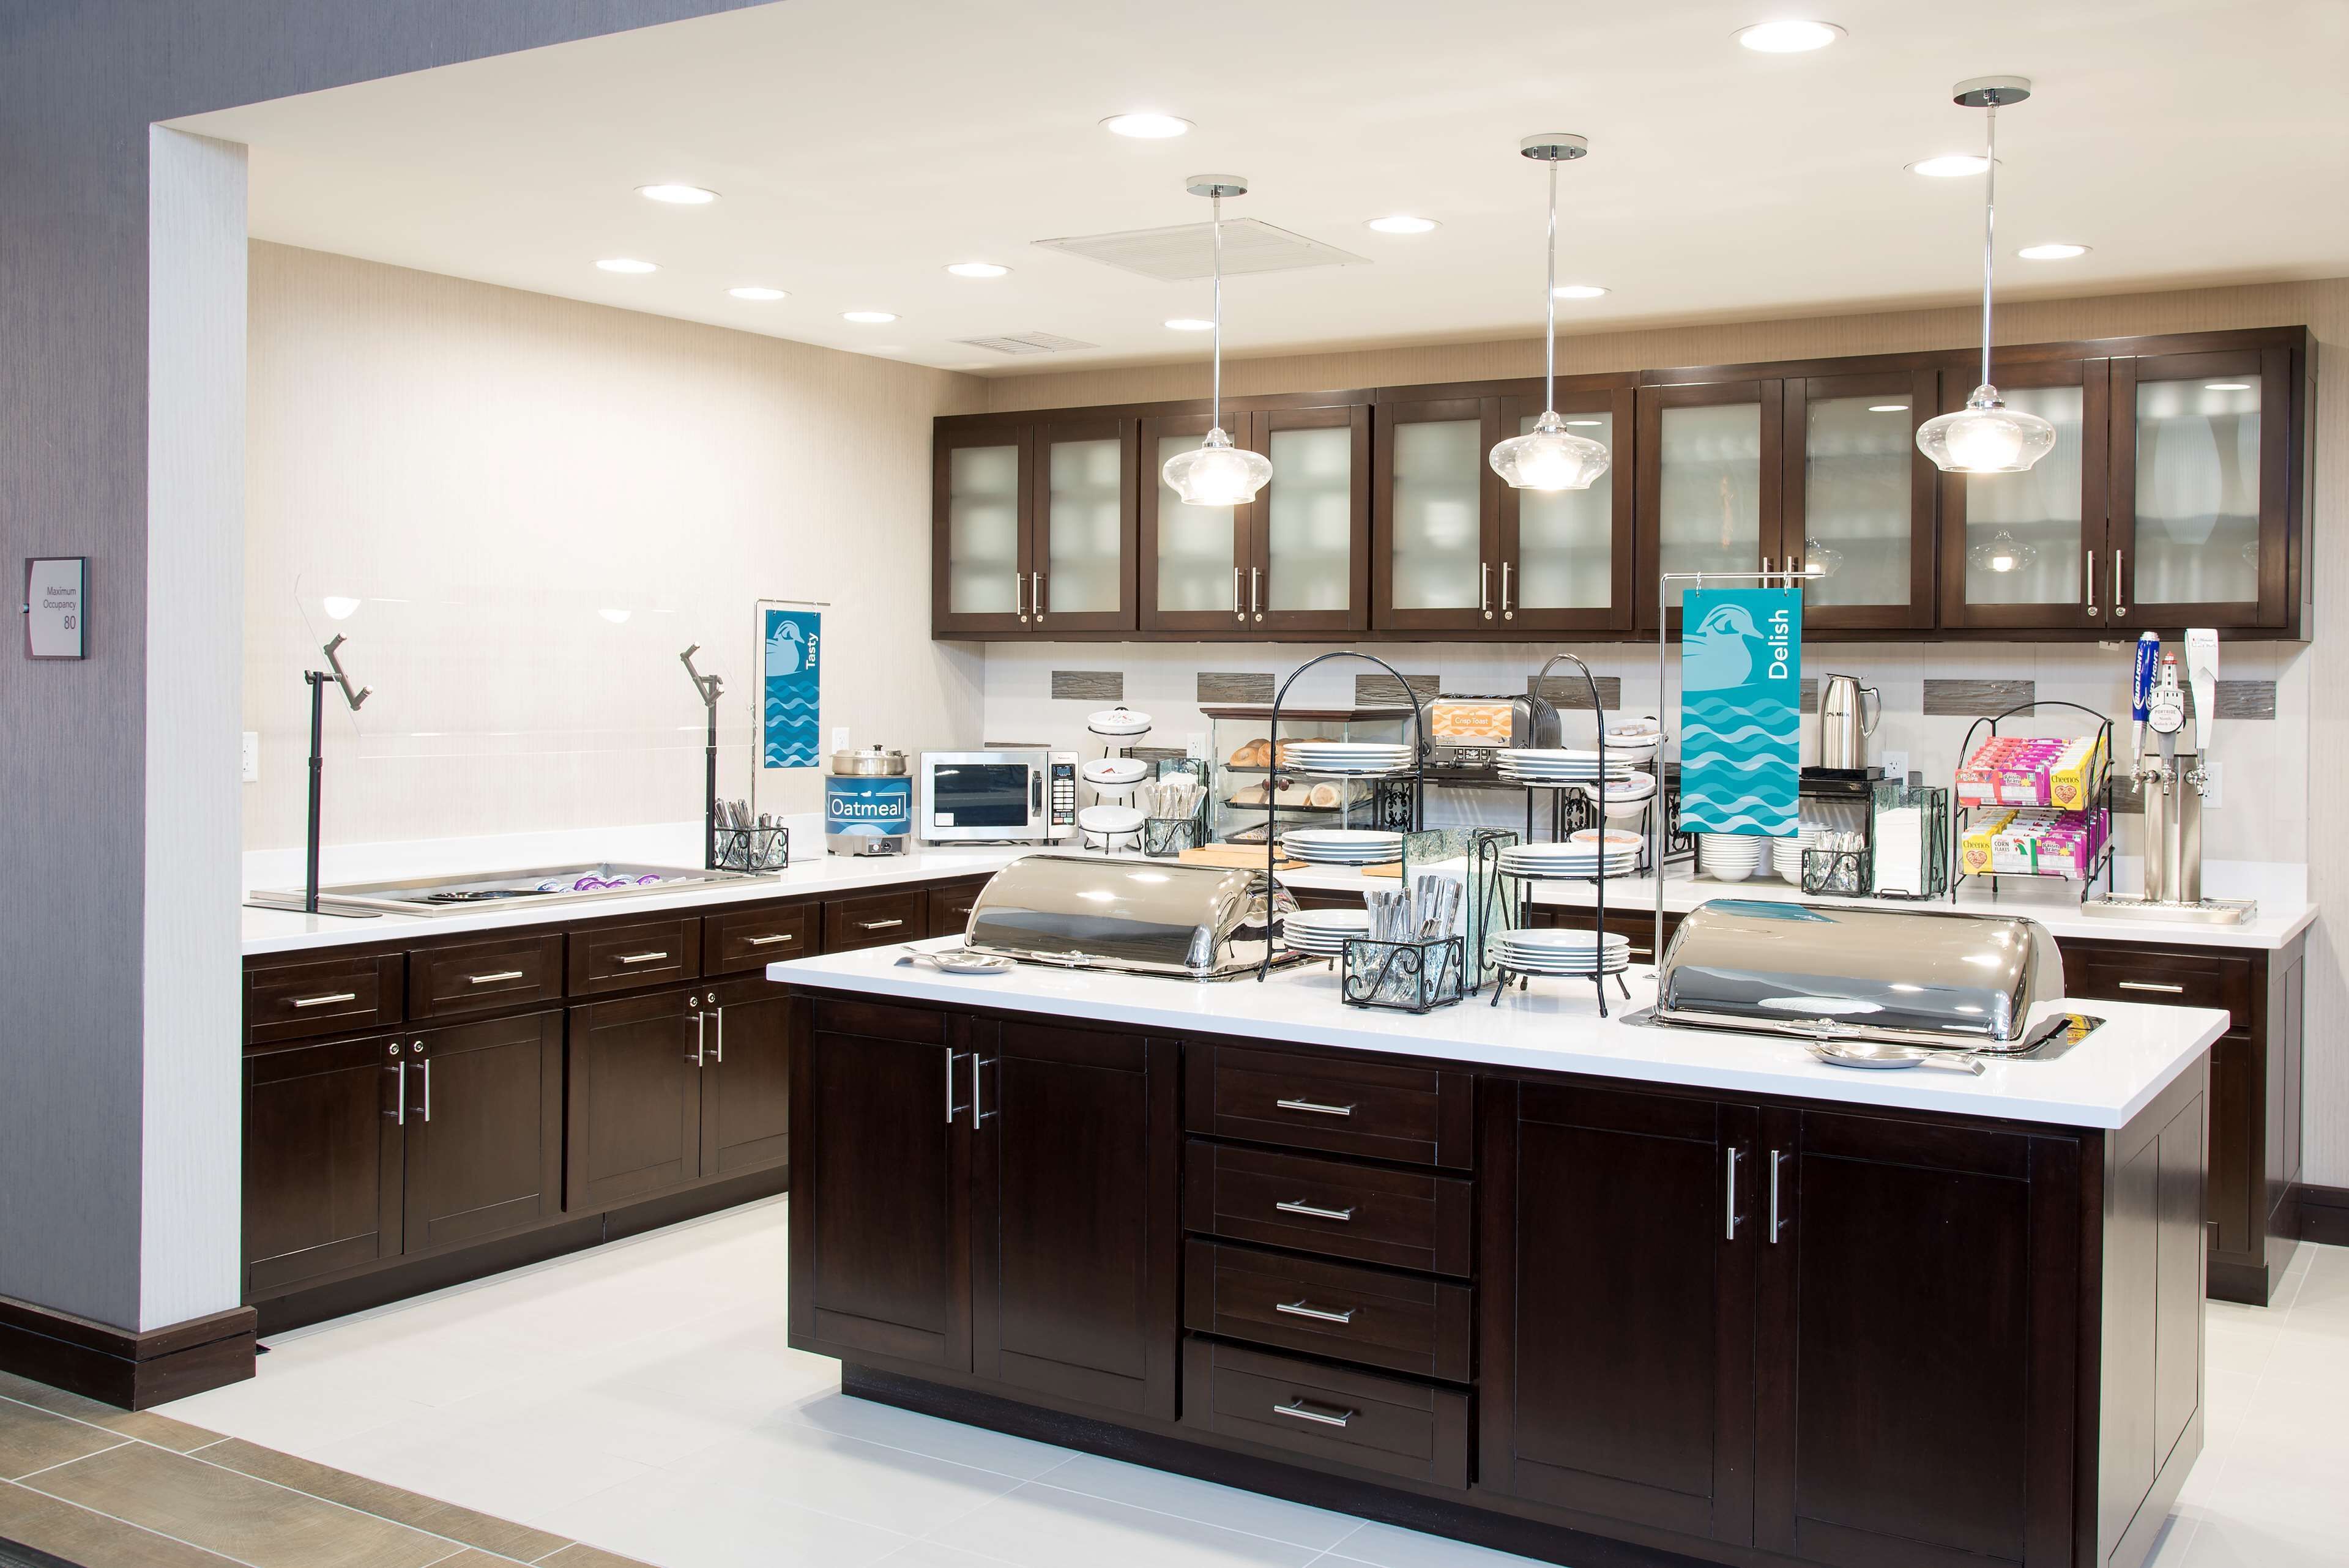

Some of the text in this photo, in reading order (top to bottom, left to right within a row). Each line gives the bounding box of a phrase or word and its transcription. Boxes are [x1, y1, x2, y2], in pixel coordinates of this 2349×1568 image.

[47, 587, 76, 595] Maximum
[43, 599, 76, 611] Occupancy
[64, 615, 76, 630] 80
[806, 632, 819, 670] Tasty
[1768, 609, 1789, 679] Delish
[2135, 648, 2143, 680] LIGHT
[832, 798, 901, 816] Oatmeal
